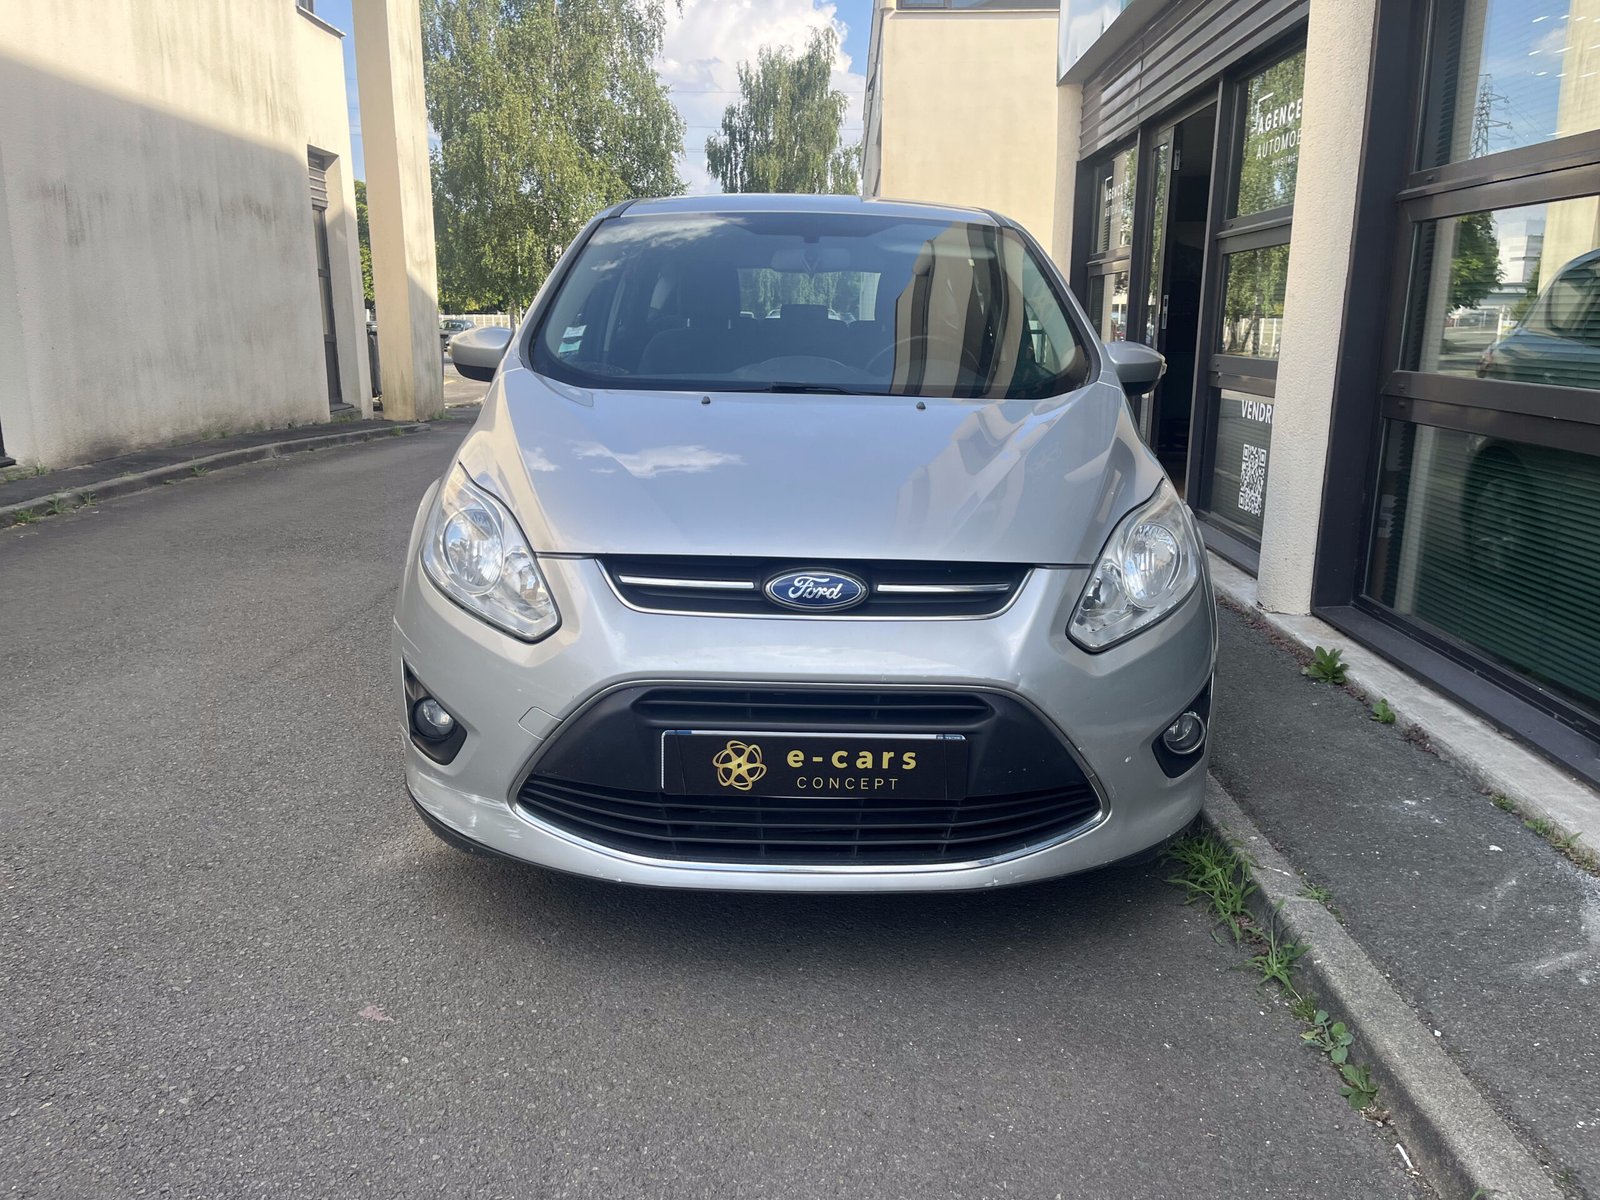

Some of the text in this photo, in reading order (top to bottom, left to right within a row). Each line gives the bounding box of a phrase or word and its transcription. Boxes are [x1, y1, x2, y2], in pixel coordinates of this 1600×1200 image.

[1258, 98, 1303, 135] AGENCE
[1241, 399, 1274, 424] VENDR
[788, 576, 843, 599] Ford
[786, 750, 917, 770] e-cars
[796, 777, 898, 790] CONCEPT
